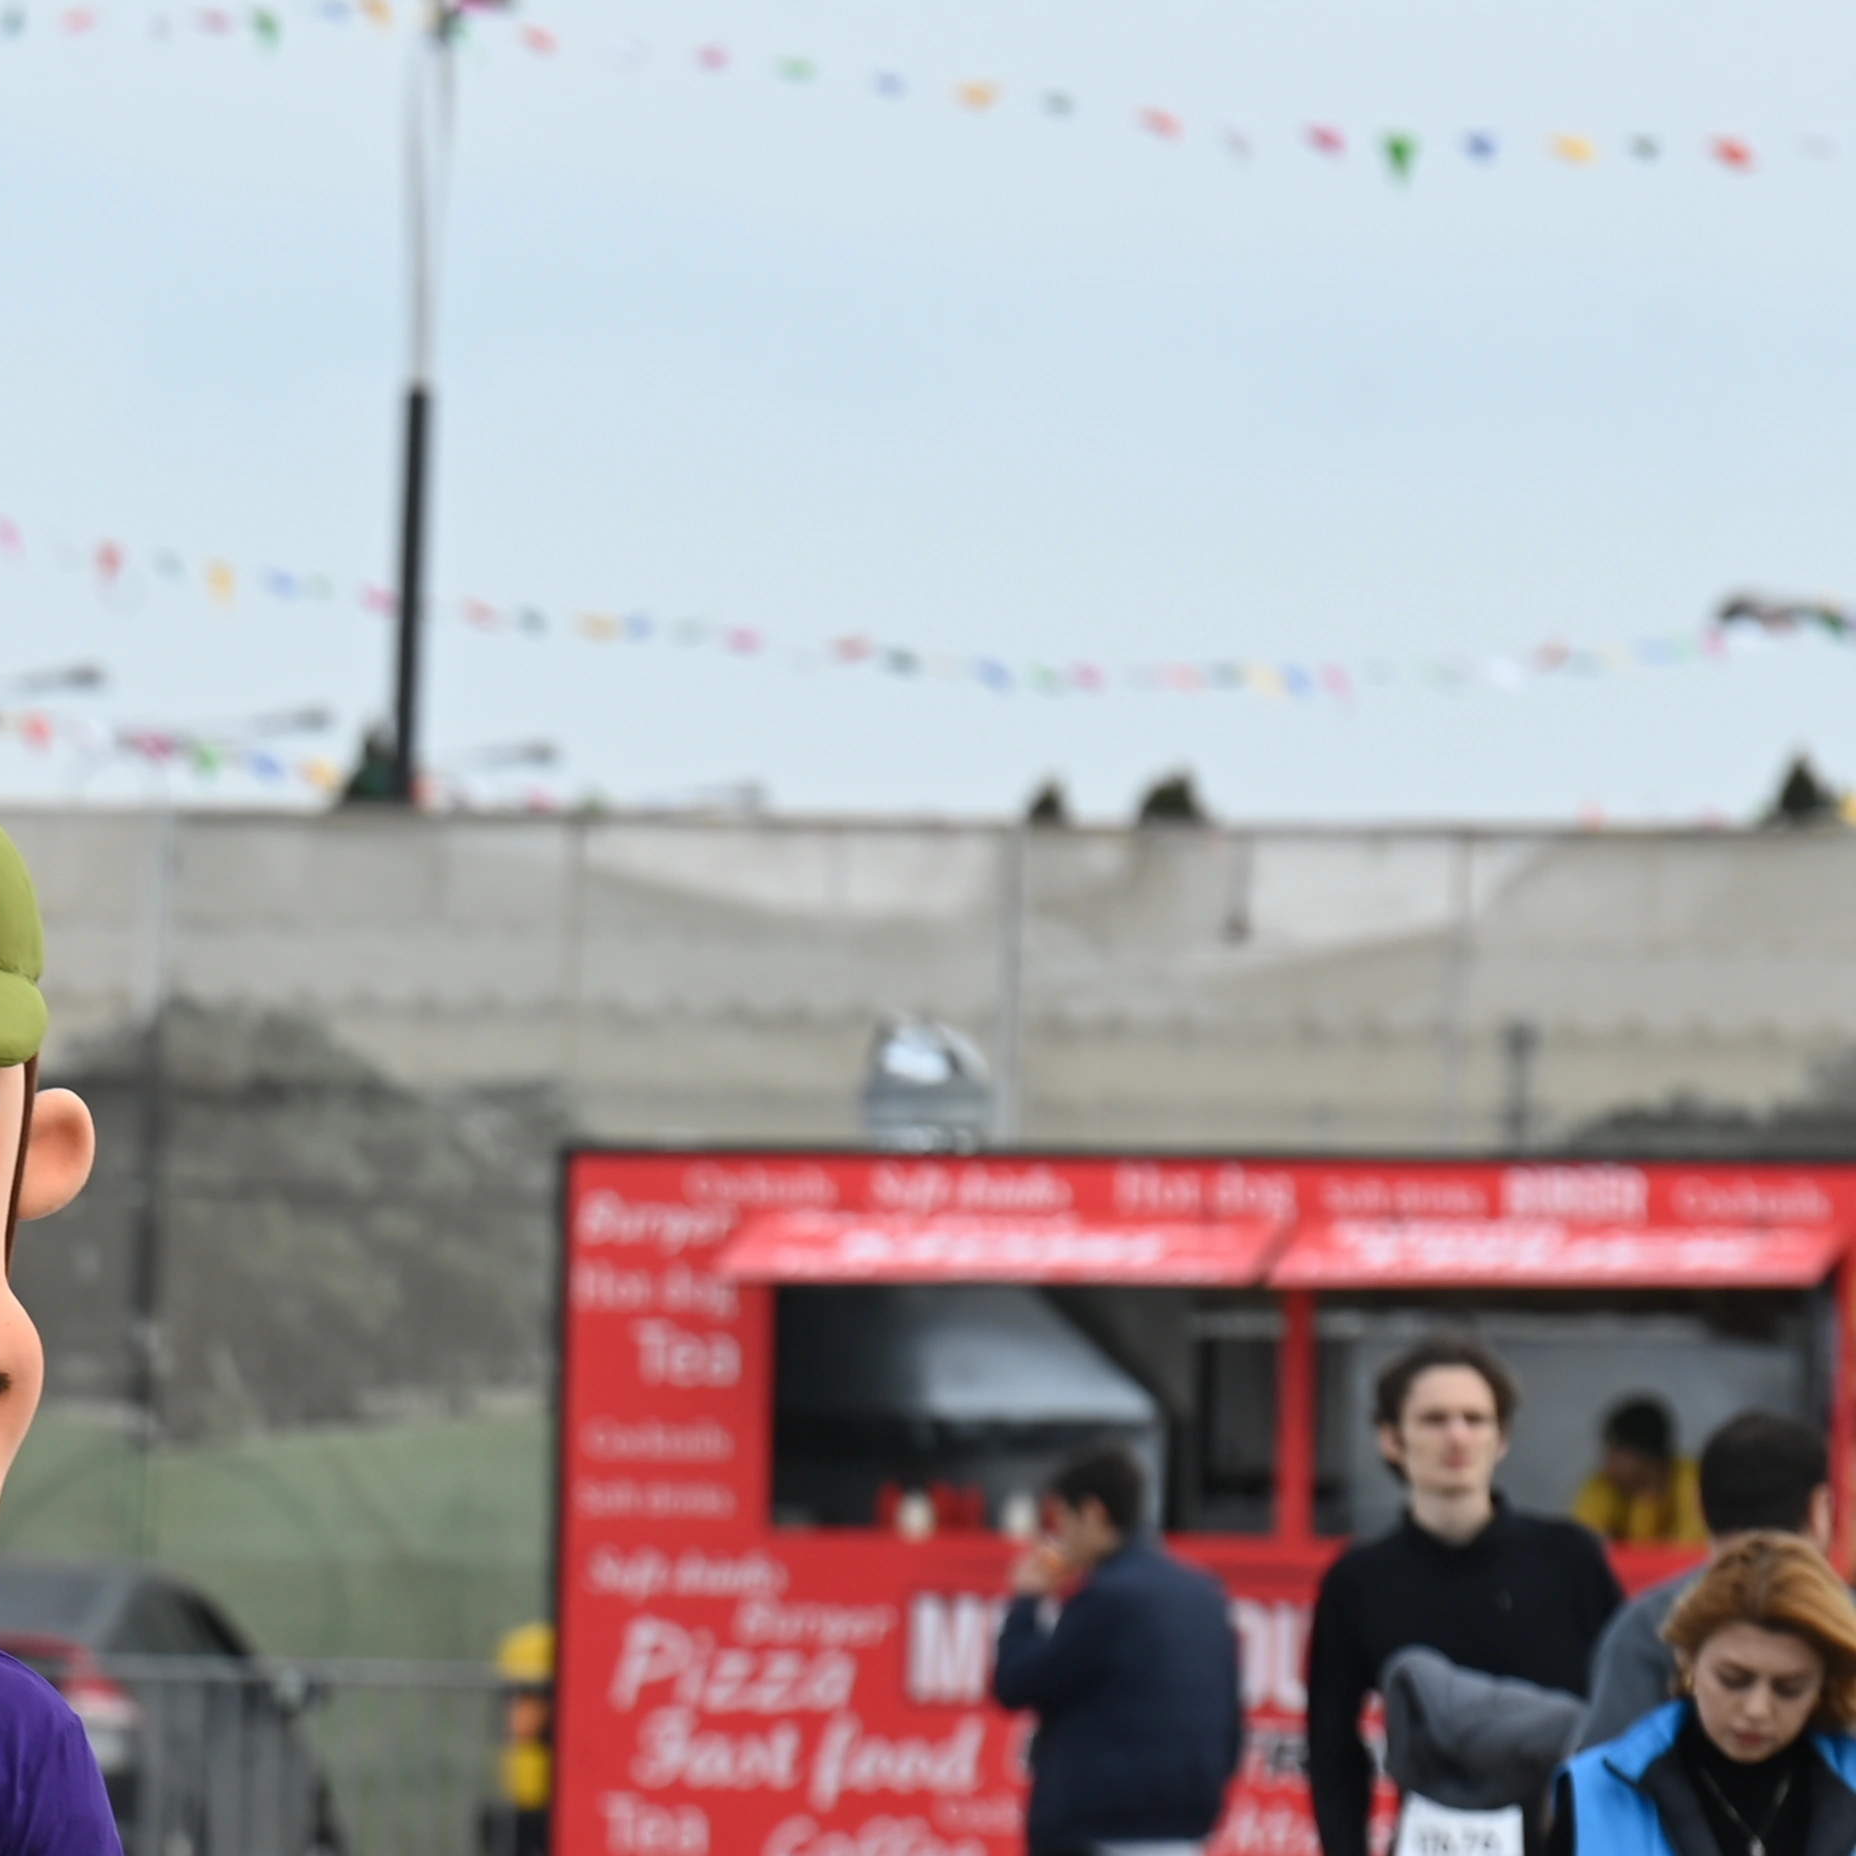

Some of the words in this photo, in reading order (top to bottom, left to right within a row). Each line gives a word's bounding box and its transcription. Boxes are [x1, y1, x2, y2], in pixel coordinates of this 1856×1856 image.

[634, 1318, 741, 1387] Tea
[612, 1616, 856, 1712] Pizza
[813, 1711, 986, 1813] food
